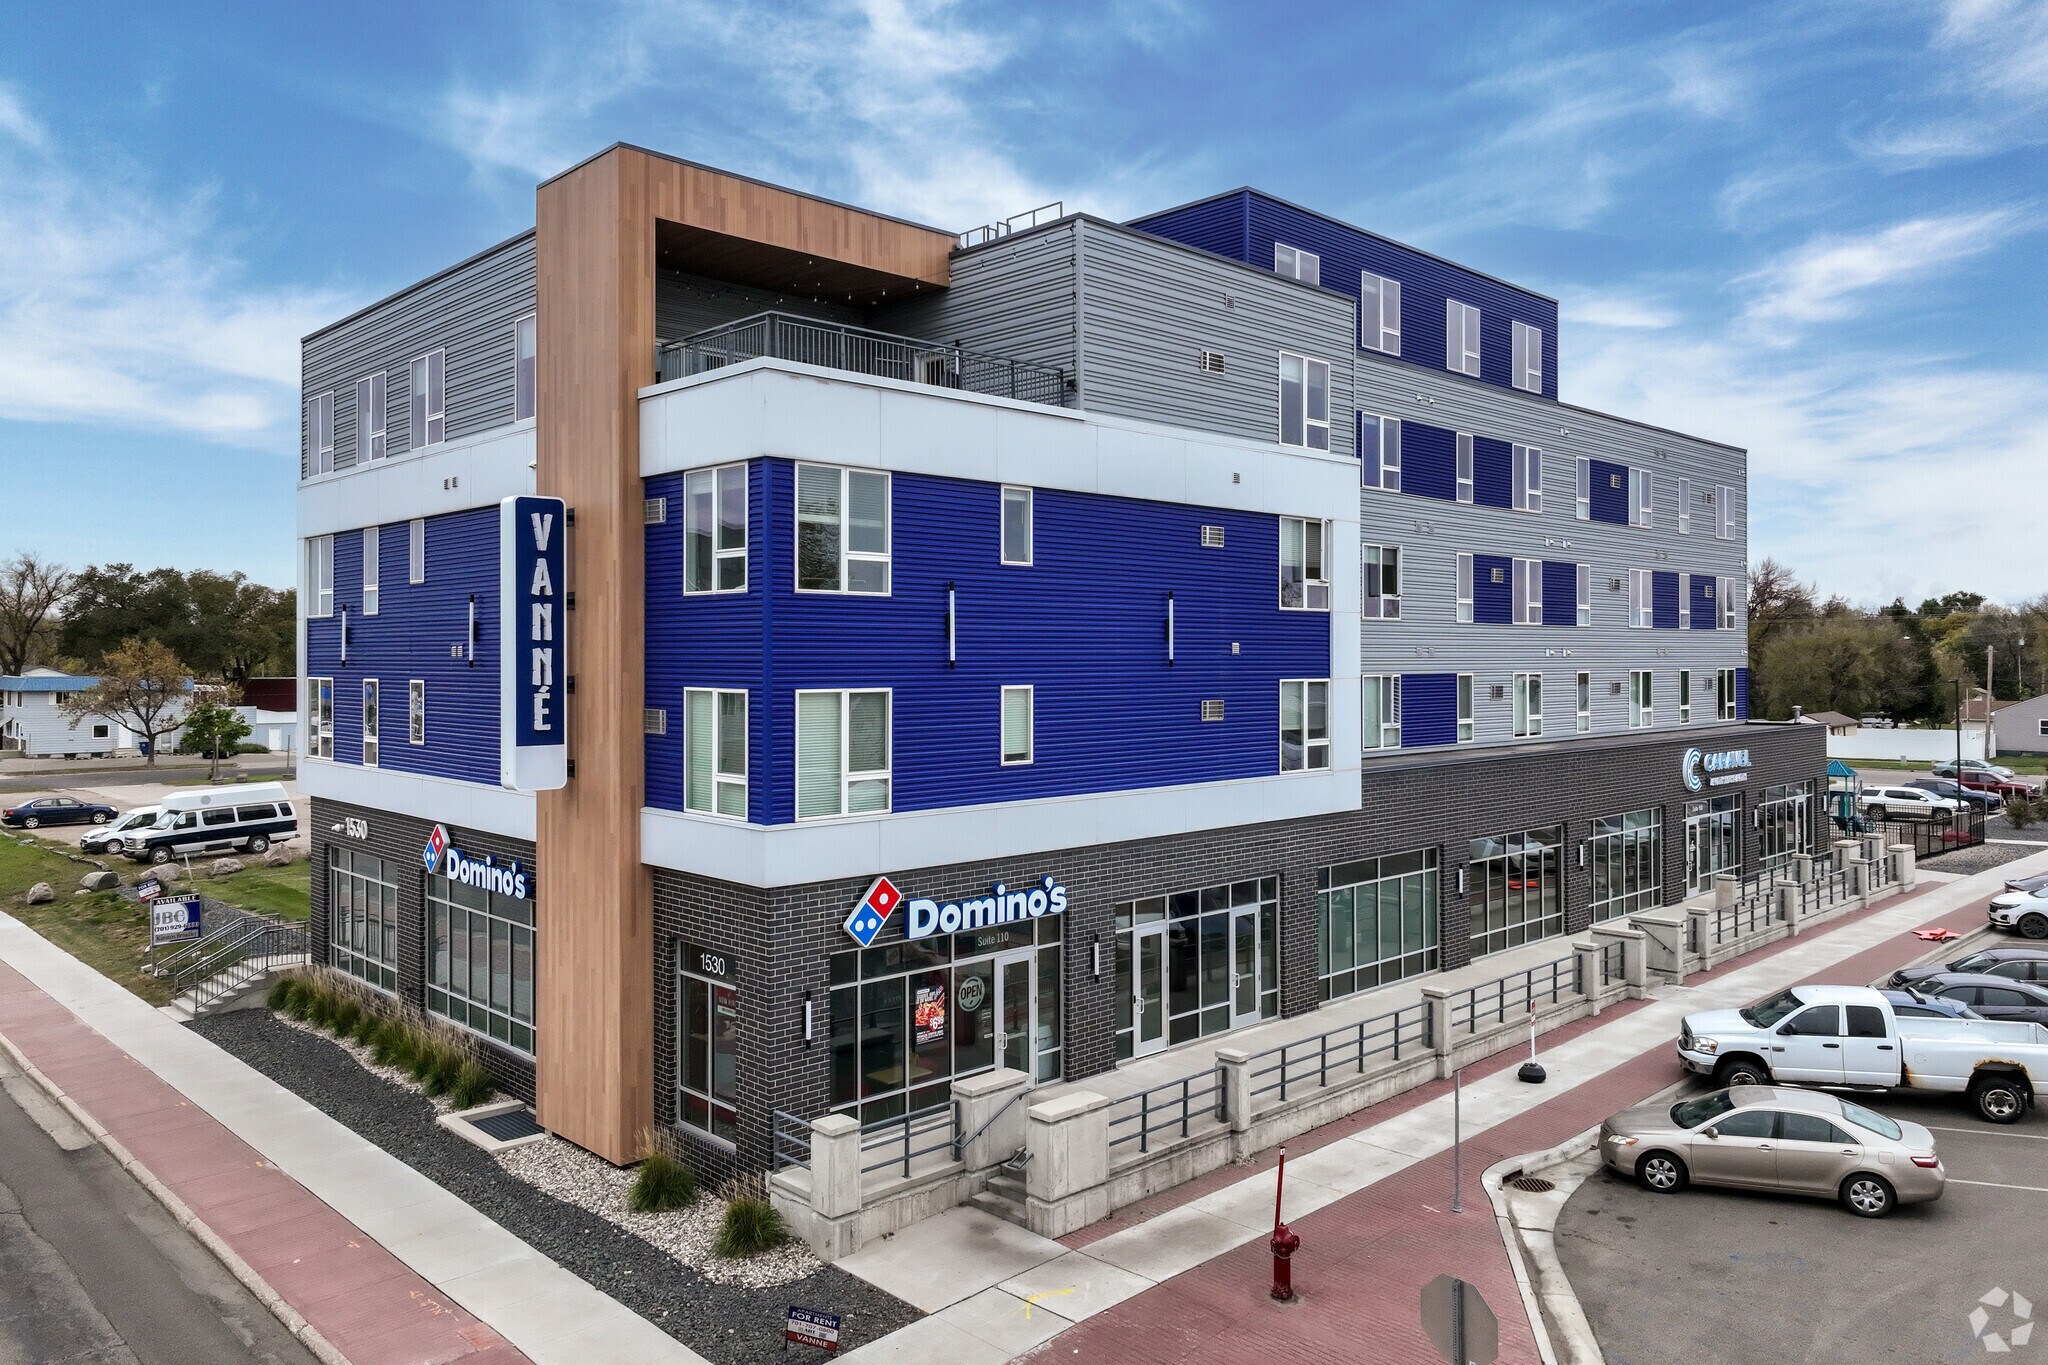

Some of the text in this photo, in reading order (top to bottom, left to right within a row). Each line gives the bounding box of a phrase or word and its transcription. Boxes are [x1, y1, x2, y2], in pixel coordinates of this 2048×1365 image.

[530, 512, 553, 731] VANNÉ
[345, 816, 368, 840] 1530
[446, 848, 529, 900] Domino's
[156, 895, 196, 905] AVAILABLE
[906, 874, 1068, 939] Domino's
[977, 931, 1010, 947] Suite 110
[700, 952, 726, 976] 1530
[960, 983, 983, 1000] OPEN
[791, 1311, 838, 1328] FOR RENT
[797, 1309, 833, 1320] APARTMENTS
[796, 1333, 829, 1348] VANNE
